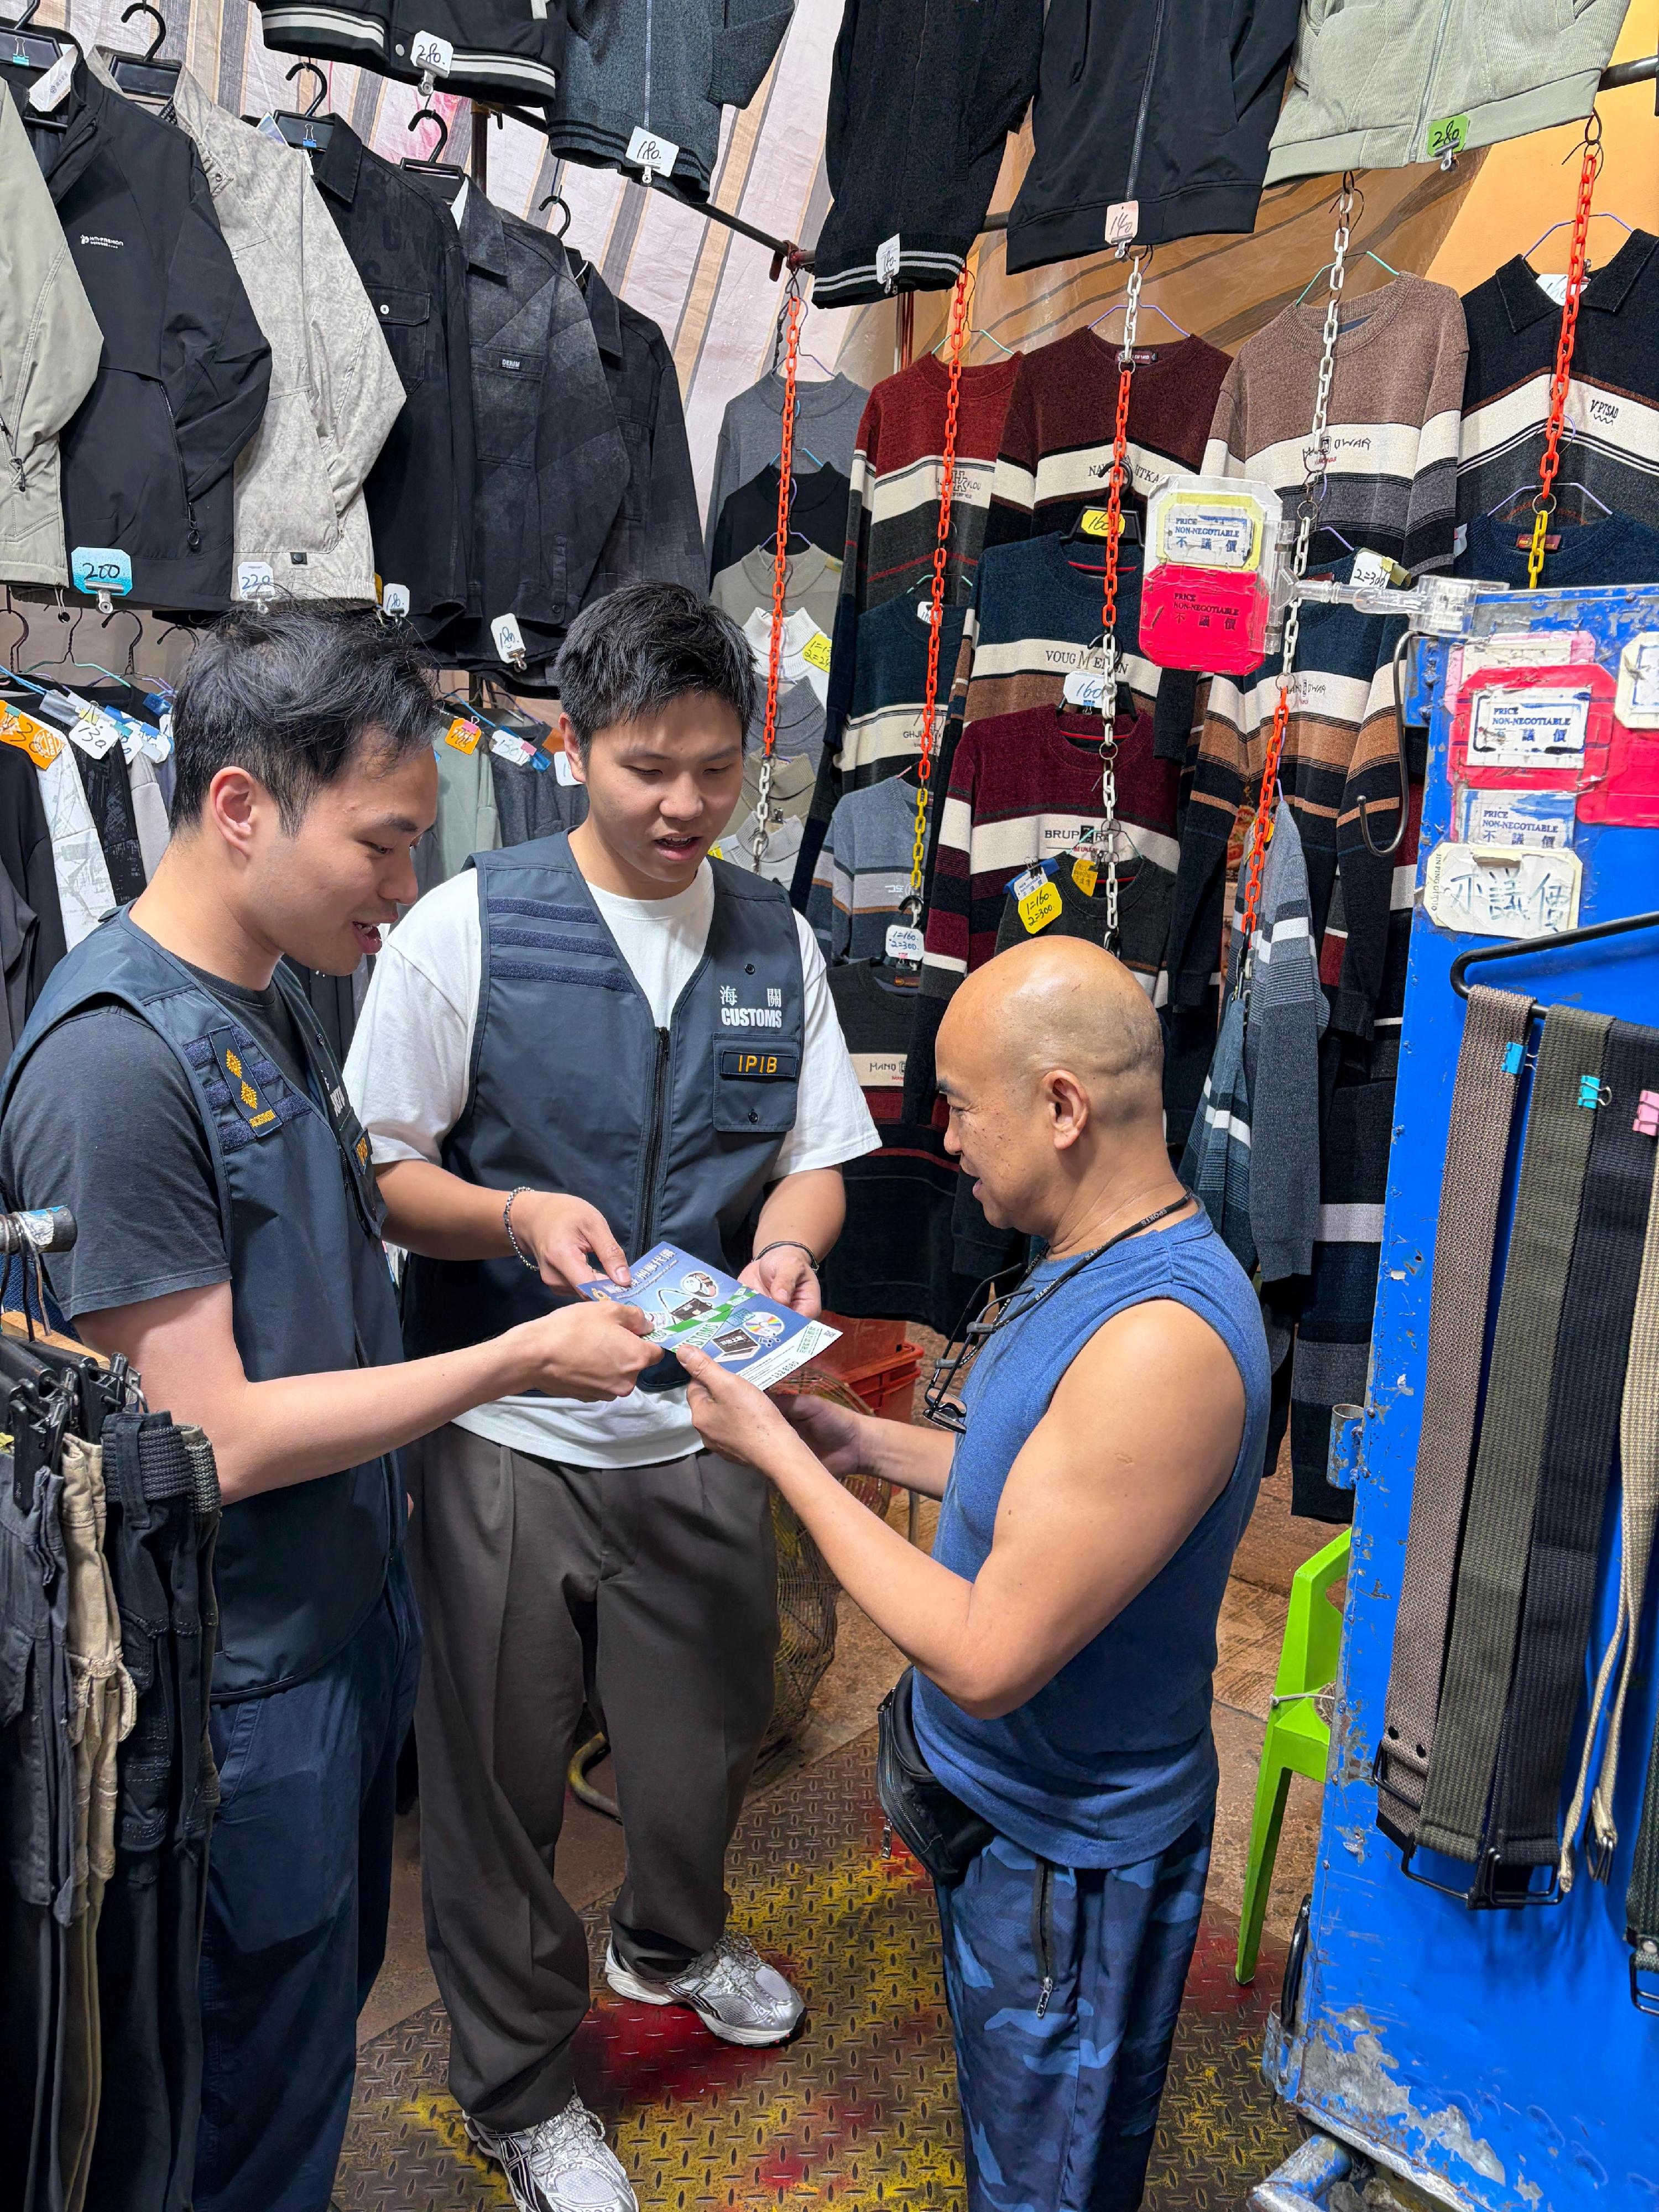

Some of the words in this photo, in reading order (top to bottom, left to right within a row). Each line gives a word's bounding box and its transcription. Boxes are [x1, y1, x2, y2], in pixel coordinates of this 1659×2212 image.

[502, 359, 520, 367] DENIM
[1175, 526, 1239, 538] NON-NEGOTIABLE
[82, 562, 120, 580] 200
[1174, 592, 1197, 602] PRICE
[1173, 602, 1239, 616] NON-NEGOTIABLE
[1046, 650, 1077, 664] VOUG
[1494, 707, 1519, 715] PRICE
[1492, 717, 1571, 726] NON-NEGOTIABLE
[1483, 810, 1509, 818] PRICE
[1482, 820, 1558, 833] NON-NEGOTIABLE
[719, 985, 782, 1008] 海關
[721, 1008, 782, 1028] CUSTOMS
[738, 1055, 778, 1074] IPIB
